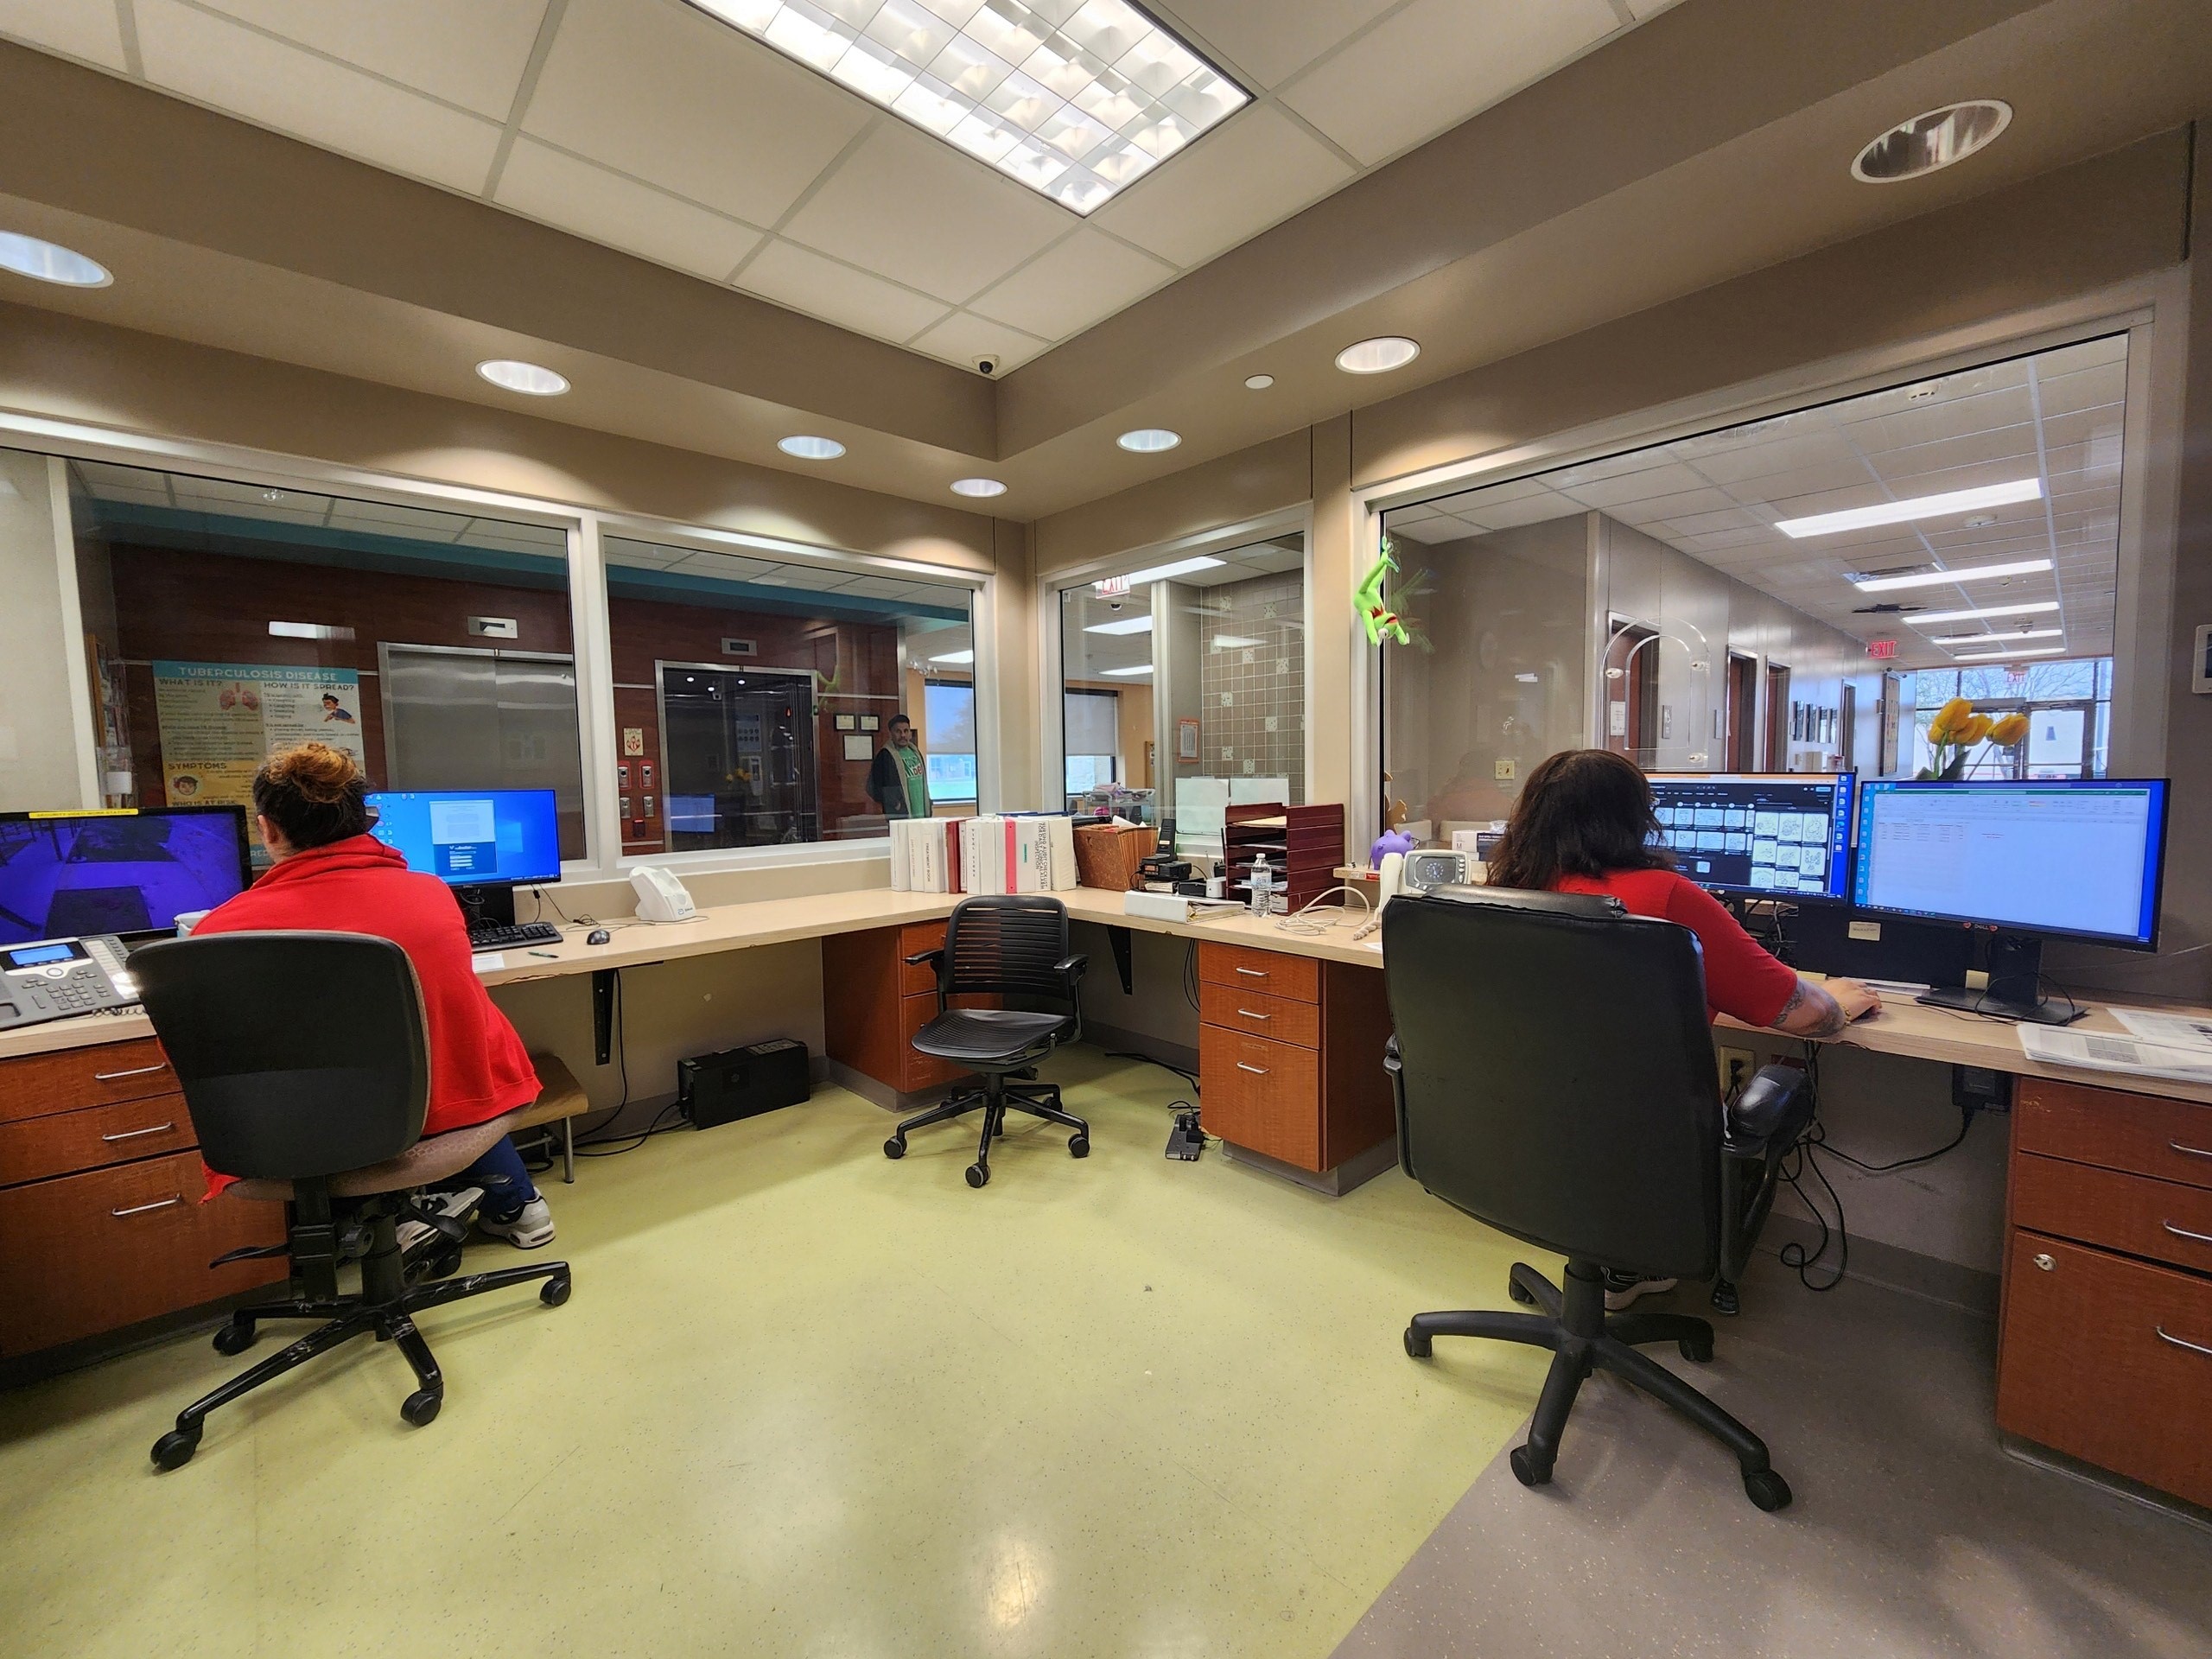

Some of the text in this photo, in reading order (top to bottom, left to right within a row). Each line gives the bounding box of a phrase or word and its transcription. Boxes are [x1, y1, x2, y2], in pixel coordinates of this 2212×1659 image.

[1871, 640, 1897, 657] EXIT
[178, 666, 337, 681] TUBERCULOSIS DISEASE
[2006, 671, 2026, 683] EXIT
